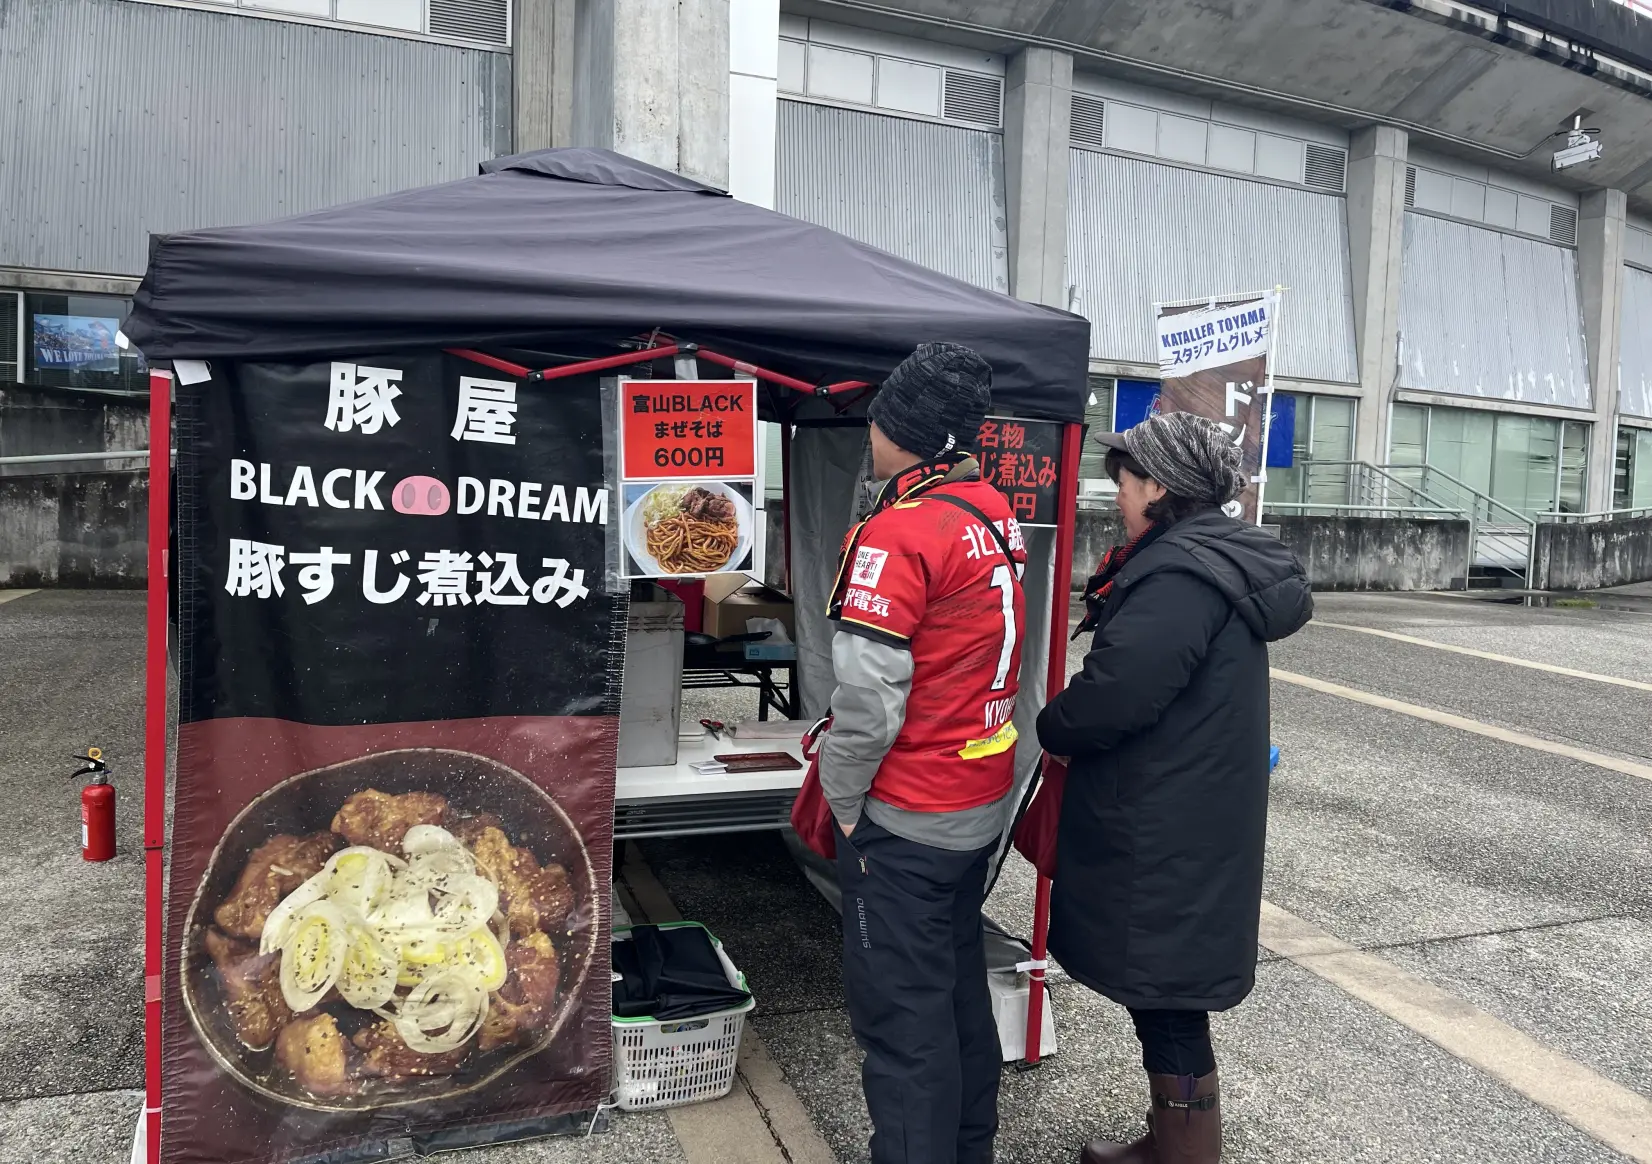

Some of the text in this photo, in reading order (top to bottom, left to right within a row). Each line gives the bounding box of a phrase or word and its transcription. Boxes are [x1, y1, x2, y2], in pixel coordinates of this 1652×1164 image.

[1161, 307, 1266, 348] KATALLER TOYAMA
[40, 347, 62, 363] WE
[62, 350, 82, 363] LOVE
[1172, 326, 1264, 366] スタジアムグルメ
[632, 394, 744, 414] 富山BLACK
[654, 420, 723, 438] まぜそば
[976, 420, 1025, 449] 名物
[654, 447, 724, 467] 600円
[971, 452, 1057, 488] じ煮込み
[230, 459, 609, 525] BLACK DREAM
[857, 550, 870, 560] ONE
[225, 538, 590, 608] 豚すじ煮込み
[856, 897, 872, 949] SHIMANO
